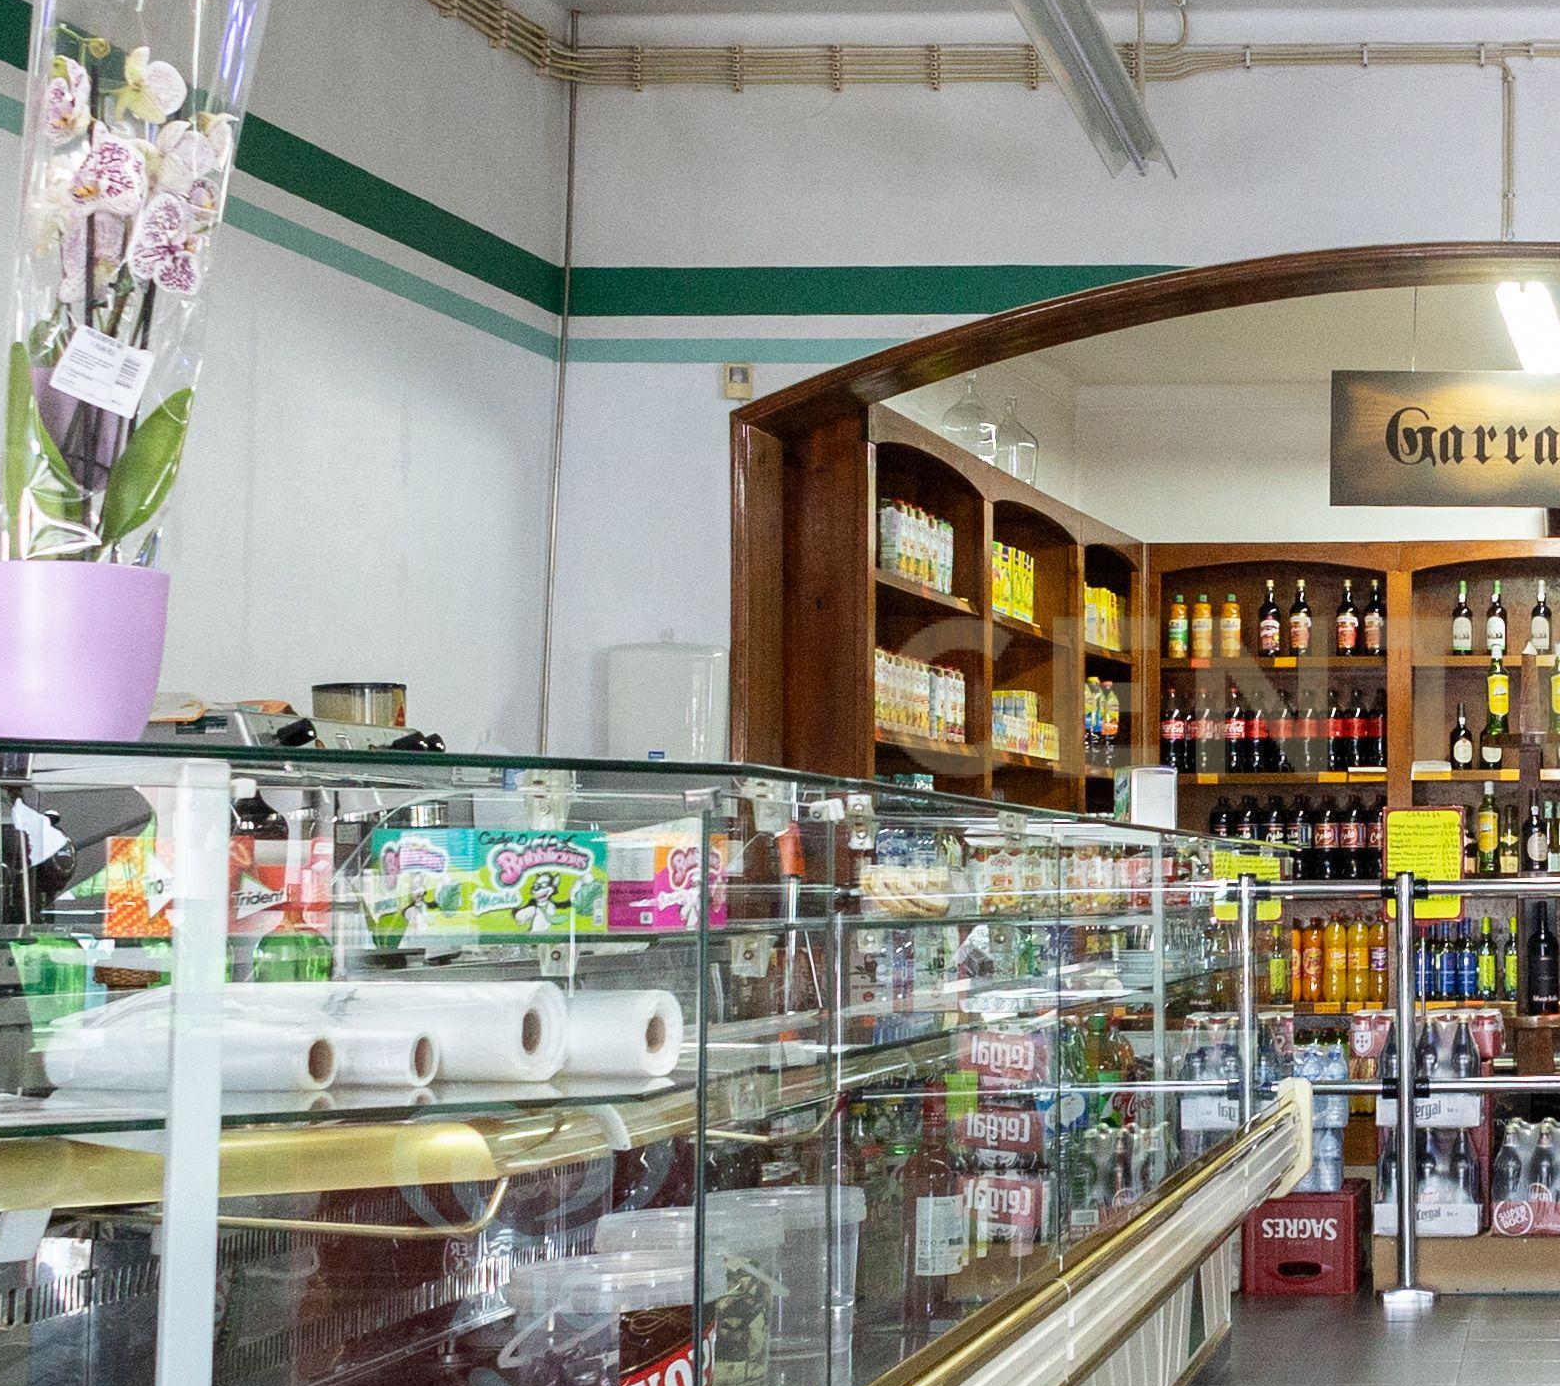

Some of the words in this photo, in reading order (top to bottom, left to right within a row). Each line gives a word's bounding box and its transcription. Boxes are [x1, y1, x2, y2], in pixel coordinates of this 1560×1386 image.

[233, 888, 284, 910] Trident
[1415, 1100, 1441, 1120] ergal
[1498, 1206, 1527, 1222] SUPER
[1503, 1214, 1529, 1230] BOCK
[1261, 1218, 1338, 1242] SAGRES
